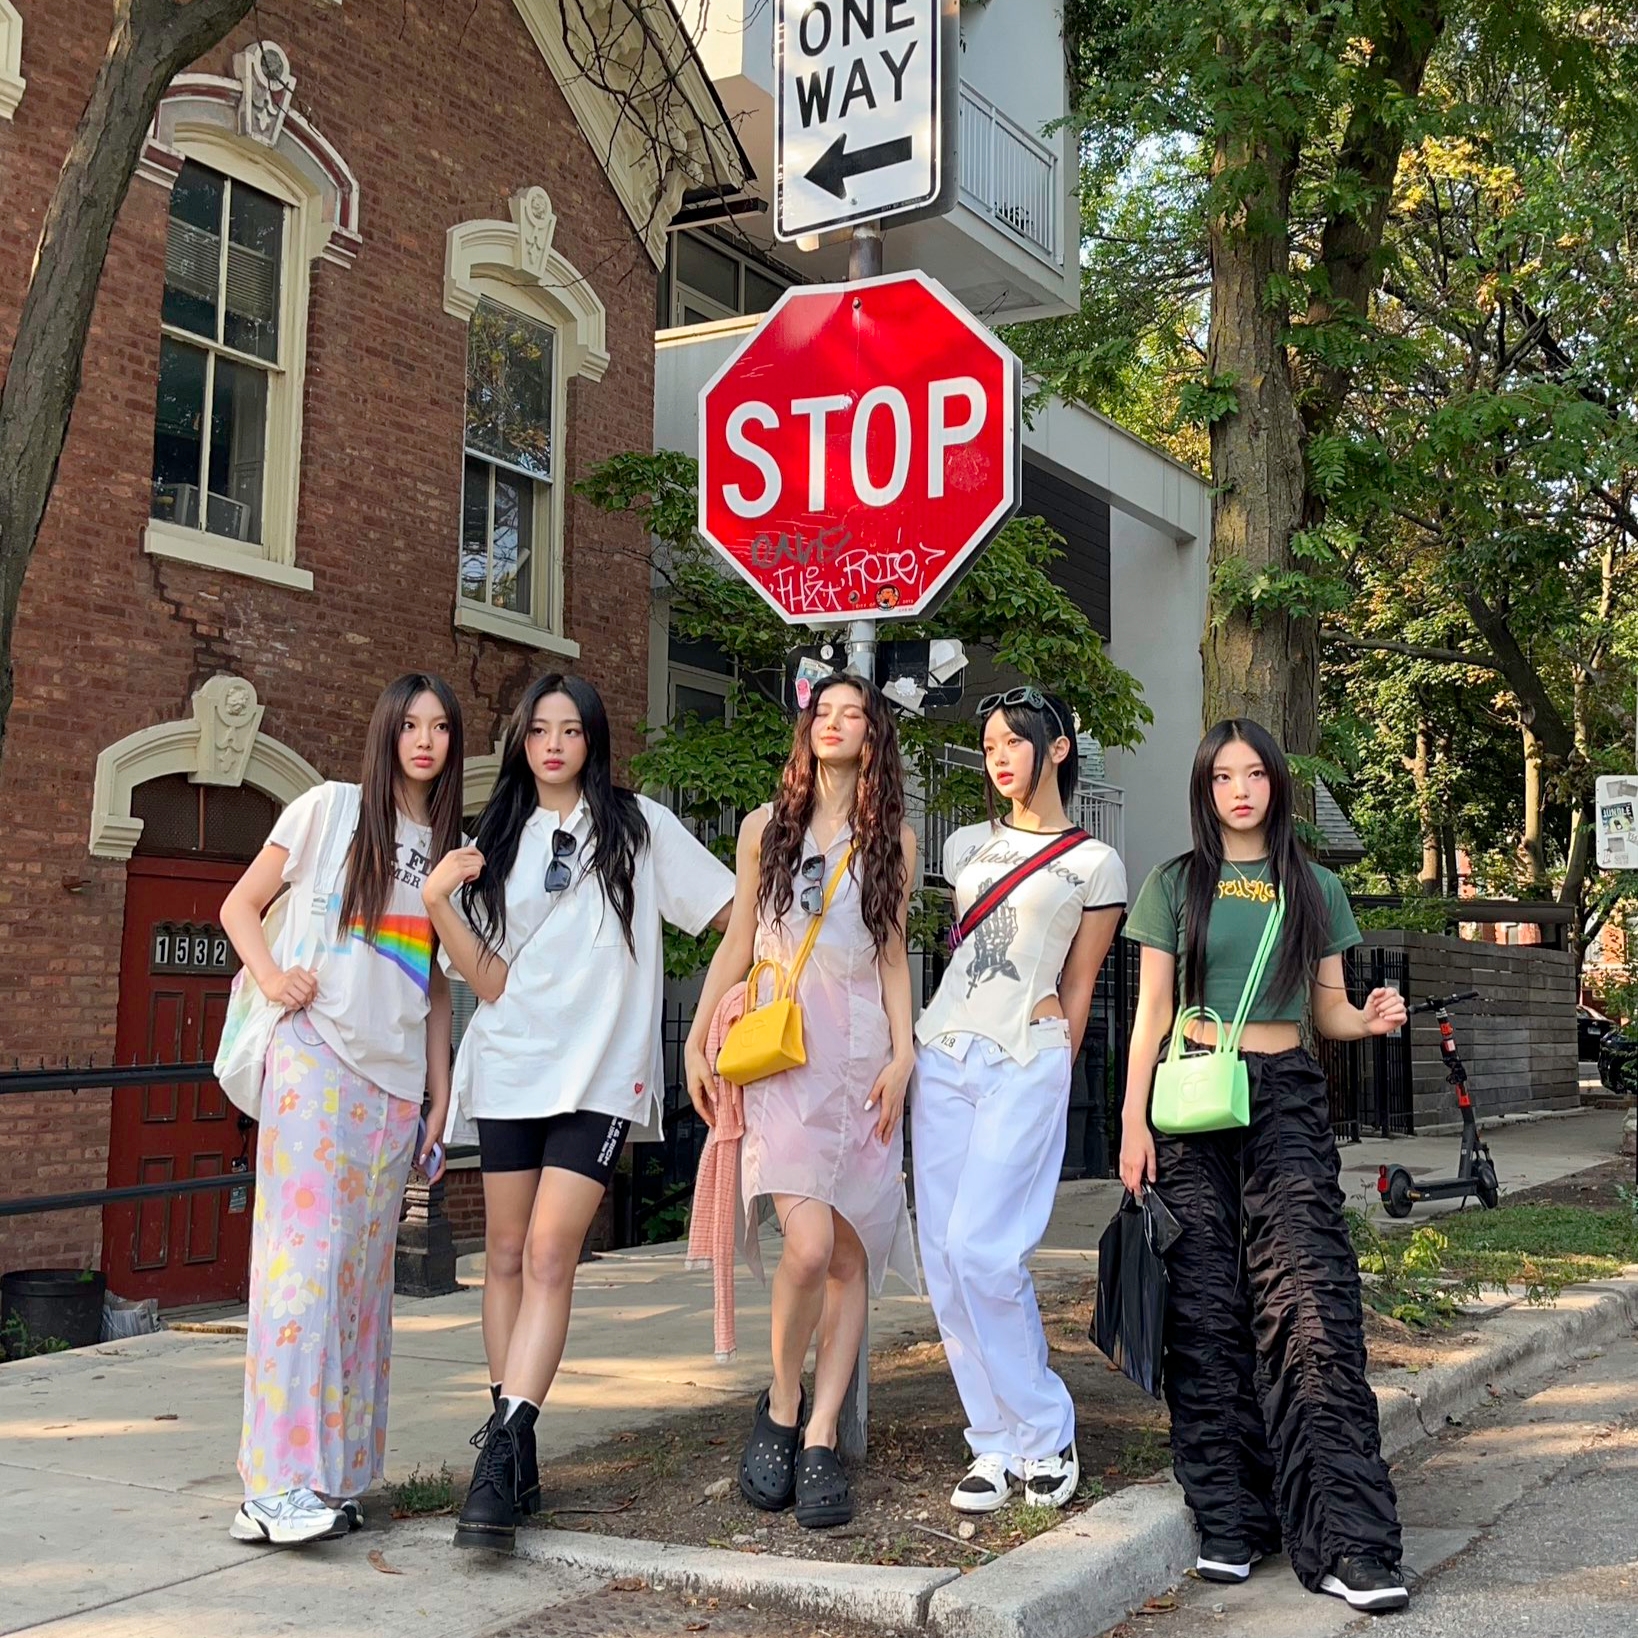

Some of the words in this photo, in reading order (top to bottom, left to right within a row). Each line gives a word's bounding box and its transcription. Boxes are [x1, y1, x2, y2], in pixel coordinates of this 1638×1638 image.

[799, 0, 915, 56] ONE
[795, 40, 918, 128] WAY
[722, 376, 987, 518] STOP
[159, 936, 226, 966] 1532
